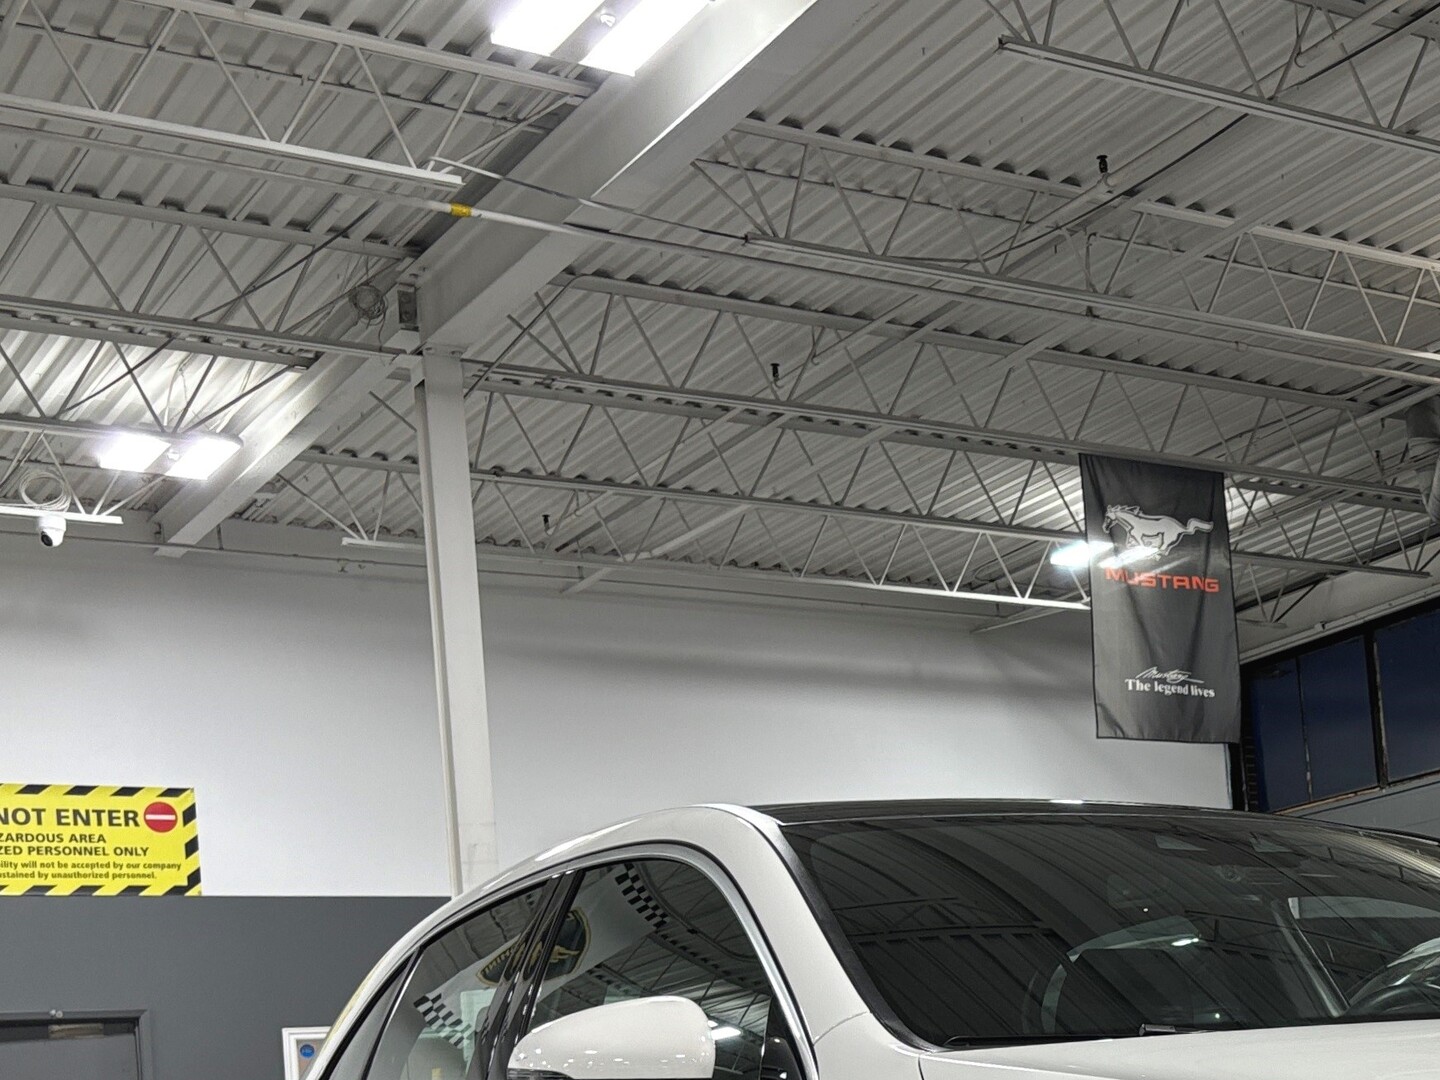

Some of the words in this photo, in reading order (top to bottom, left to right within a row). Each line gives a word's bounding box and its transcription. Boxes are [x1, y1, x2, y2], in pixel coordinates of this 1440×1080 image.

[1104, 566, 1220, 593] MUSTANG
[1125, 679, 1151, 692] The
[1154, 680, 1189, 696] legend
[1191, 684, 1215, 698] lives
[56, 808, 140, 827] ENTER
[69, 833, 107, 844] AREA
[27, 845, 110, 856] PERSONNEL
[113, 846, 149, 857] ONLY
[21, 860, 38, 868] will
[40, 861, 55, 869] not
[57, 860, 68, 869] be
[71, 861, 111, 870] accepted
[113, 861, 124, 870] by
[143, 862, 181, 871] company
[38, 870, 49, 880] by
[51, 870, 109, 879] unauthorized
